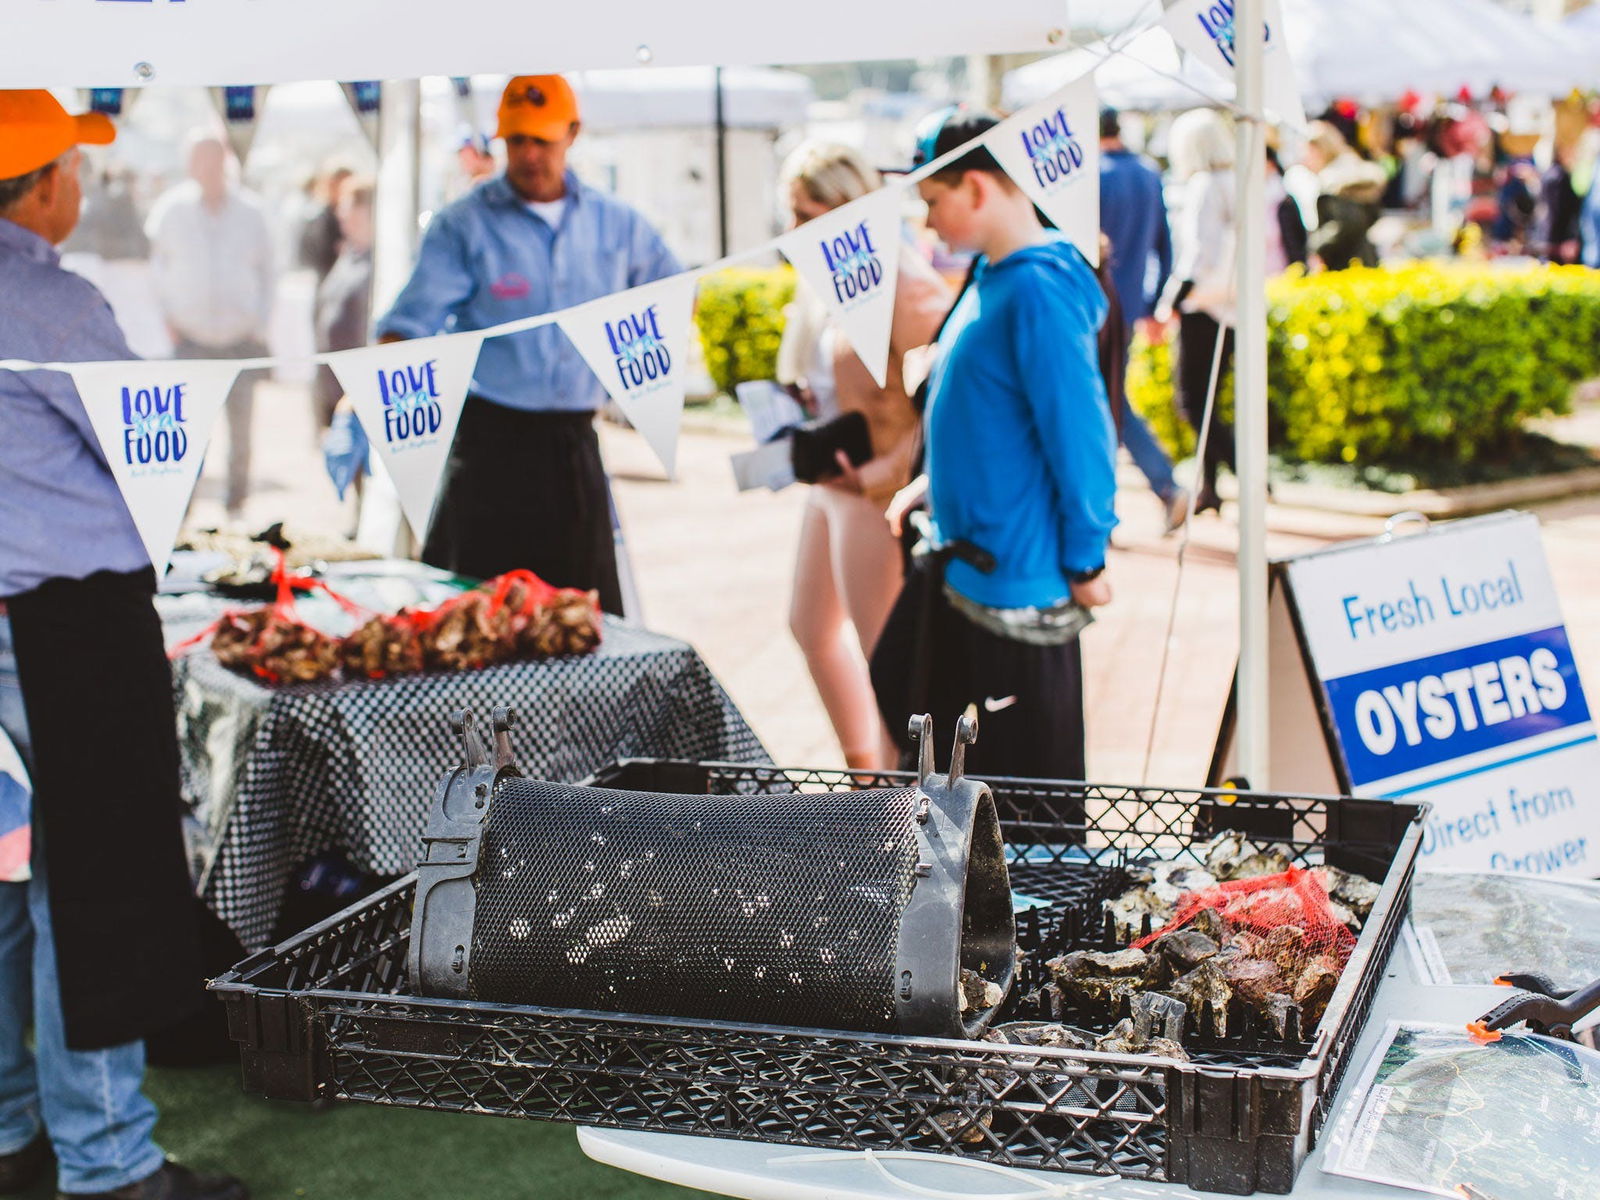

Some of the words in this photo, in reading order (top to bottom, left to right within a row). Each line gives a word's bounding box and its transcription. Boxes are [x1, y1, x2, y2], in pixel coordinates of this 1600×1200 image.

[1021, 107, 1072, 158] LOVE
[1032, 141, 1083, 187] FOOD
[821, 220, 876, 271] LOVE
[833, 257, 882, 303] FOOD
[604, 304, 664, 355] LOVE
[377, 360, 440, 406] LOVE
[616, 344, 671, 389] FOOD
[121, 382, 188, 425] LOVE
[384, 401, 441, 442] FOOD
[124, 427, 188, 464] FOOD
[1342, 581, 1436, 640] Fresh
[1442, 561, 1524, 616] Local
[1354, 648, 1568, 756] OYSTERS
[1508, 787, 1575, 825] from
